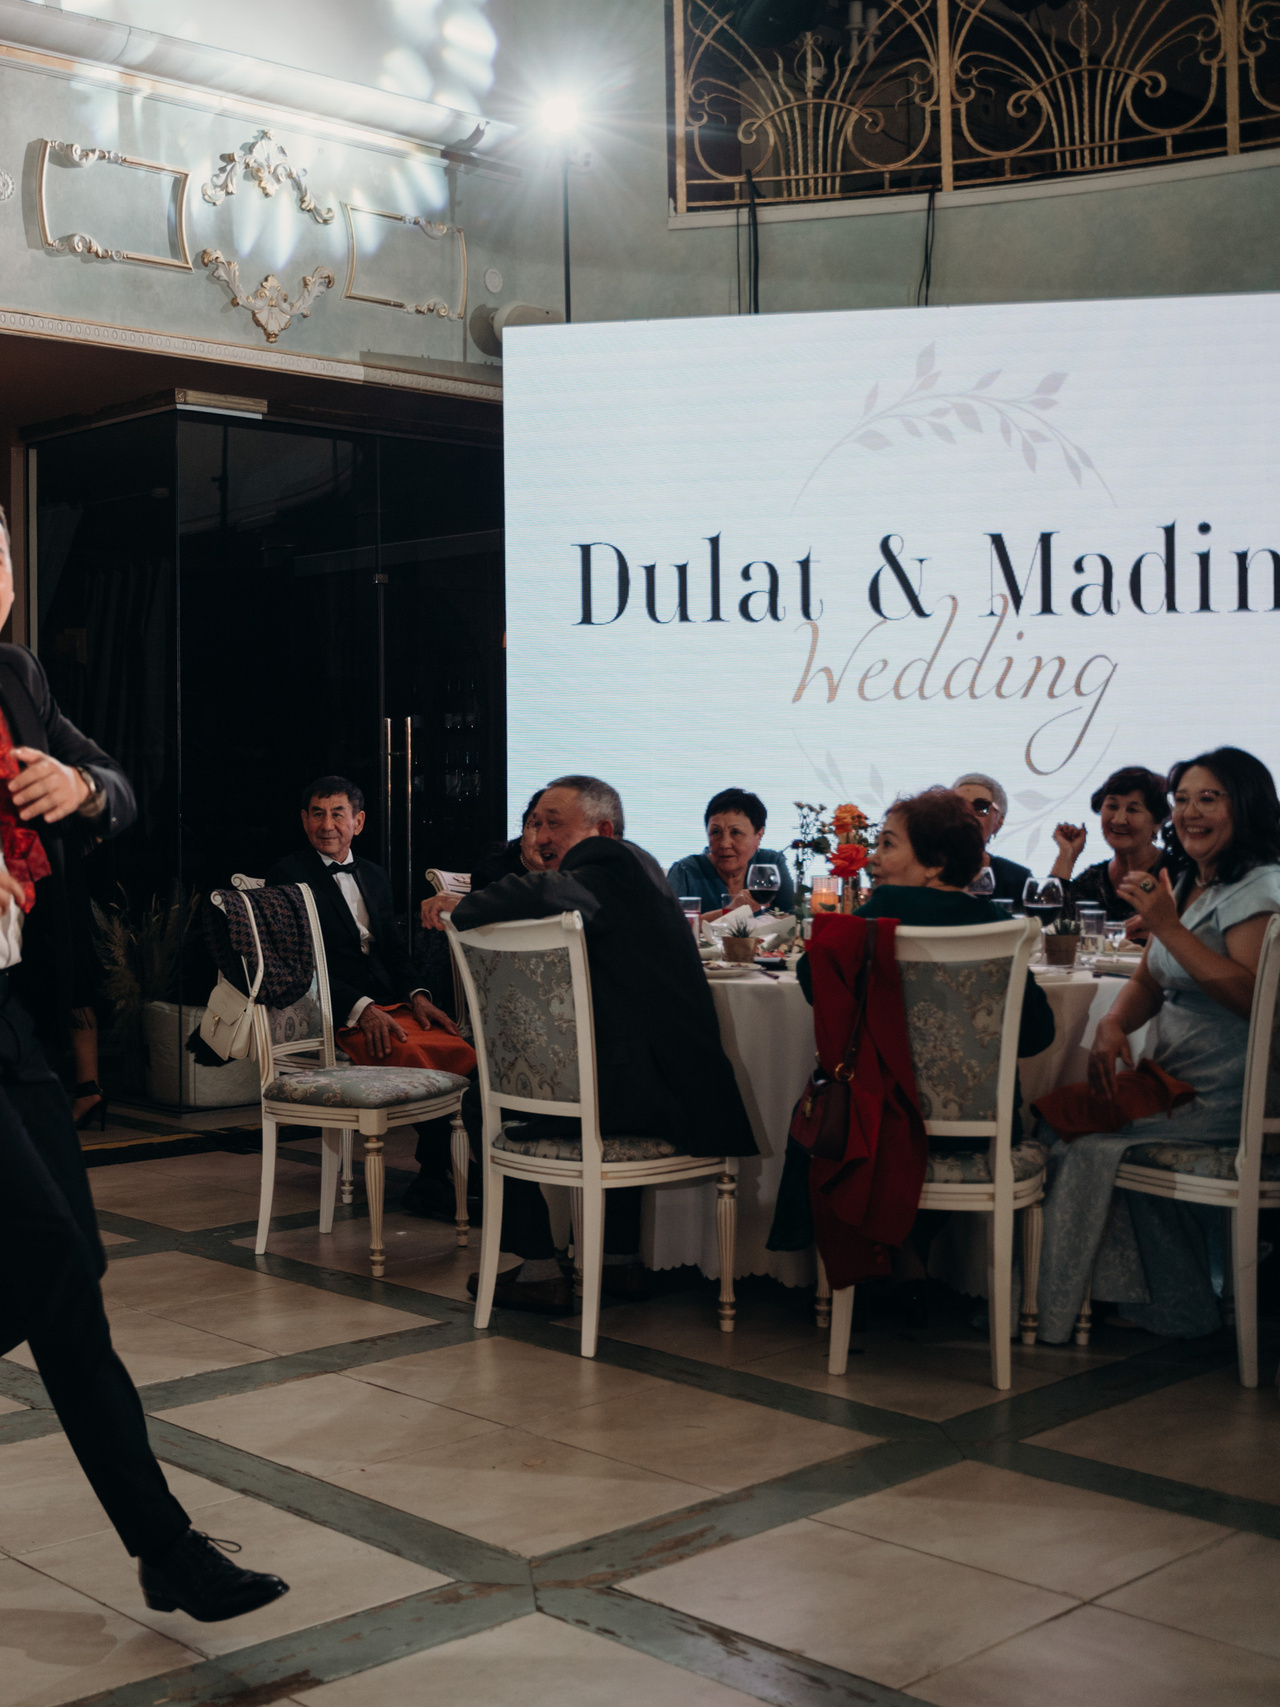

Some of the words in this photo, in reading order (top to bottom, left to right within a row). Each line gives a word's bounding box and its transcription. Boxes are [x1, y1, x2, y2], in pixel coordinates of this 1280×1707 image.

[571, 531, 824, 626] Dulat
[868, 534, 935, 621] &
[792, 593, 1119, 776] Wedding
